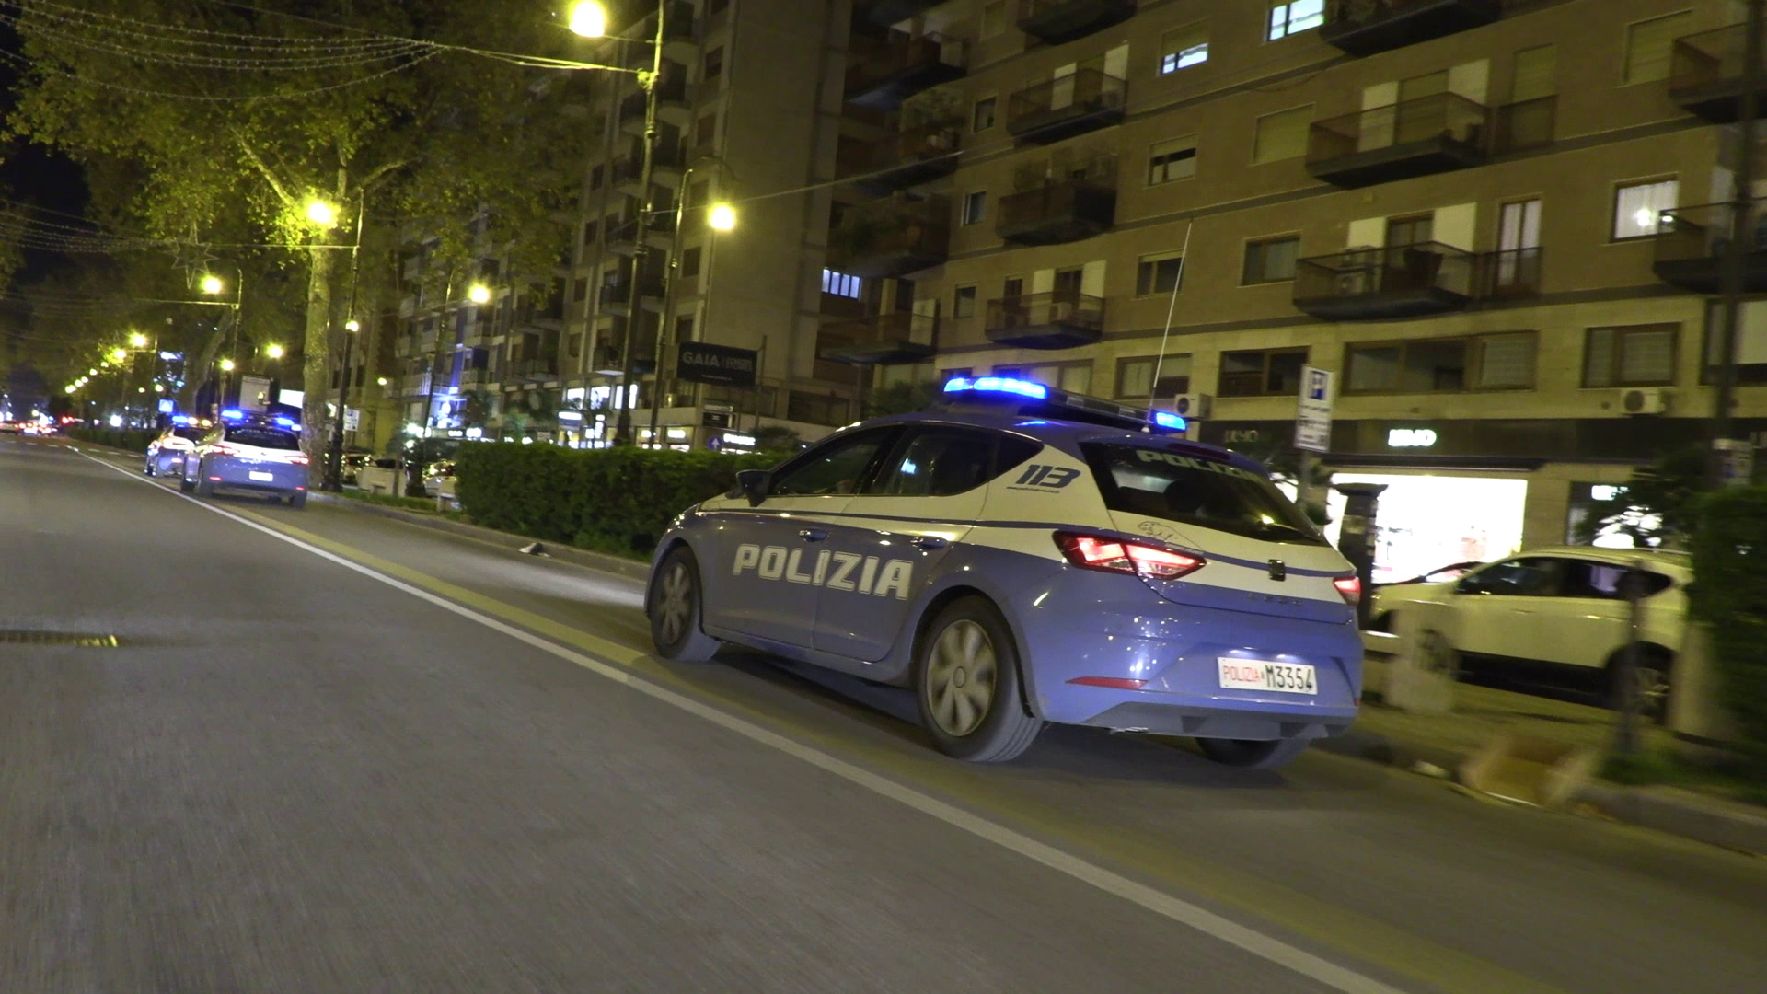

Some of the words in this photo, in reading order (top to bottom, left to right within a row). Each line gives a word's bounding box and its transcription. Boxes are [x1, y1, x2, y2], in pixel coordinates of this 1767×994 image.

[682, 351, 721, 368] GAIA
[1015, 464, 1081, 489] 113
[1136, 450, 1268, 482] POLIZ
[732, 543, 914, 601] POLIZIA
[1264, 664, 1312, 689] M3354
